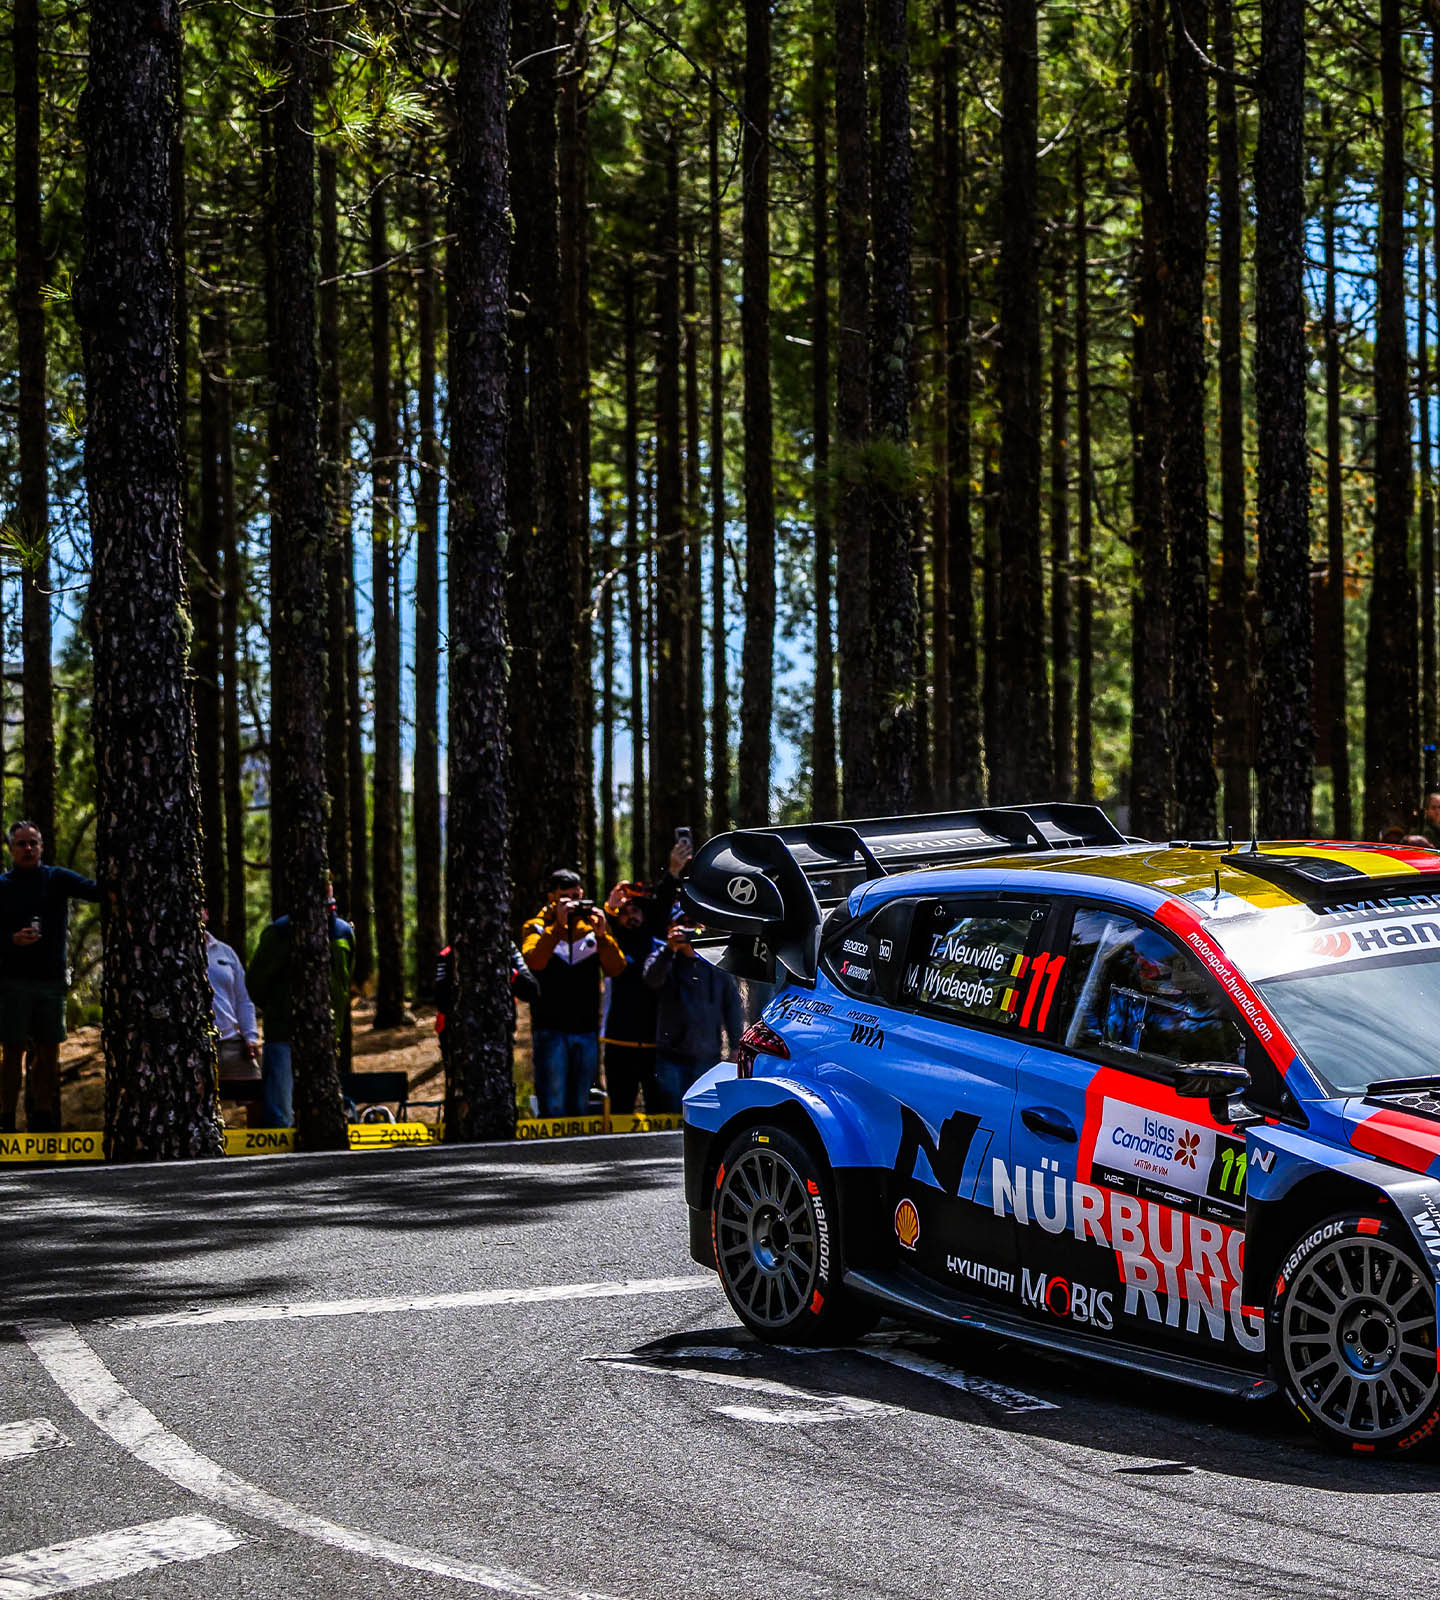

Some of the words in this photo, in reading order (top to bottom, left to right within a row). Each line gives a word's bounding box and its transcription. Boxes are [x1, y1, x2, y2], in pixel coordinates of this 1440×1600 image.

[842, 939, 869, 957] sparco
[929, 933, 943, 958] T.
[943, 936, 1005, 972] Neuville
[922, 966, 994, 1008] Wydaeghe
[1018, 951, 1068, 1033] 11
[1186, 931, 1274, 1043] motorsport.hyundai.com
[786, 1008, 814, 1027] STEEL
[796, 996, 835, 1017] HYUNDAI
[847, 1009, 880, 1025] HYUNDAI
[245, 1132, 289, 1149] ZONA
[517, 1123, 549, 1140] ONA
[1112, 1126, 1174, 1161] Canarias
[1143, 1116, 1175, 1143] Islas
[0, 1138, 21, 1155] NA
[25, 1137, 94, 1155] PUBLICO
[1220, 1147, 1247, 1196] 11
[946, 1254, 1016, 1294] HYUNDAI
[1020, 1266, 1114, 1331] MOBIS
[1121, 1250, 1266, 1353] RING
